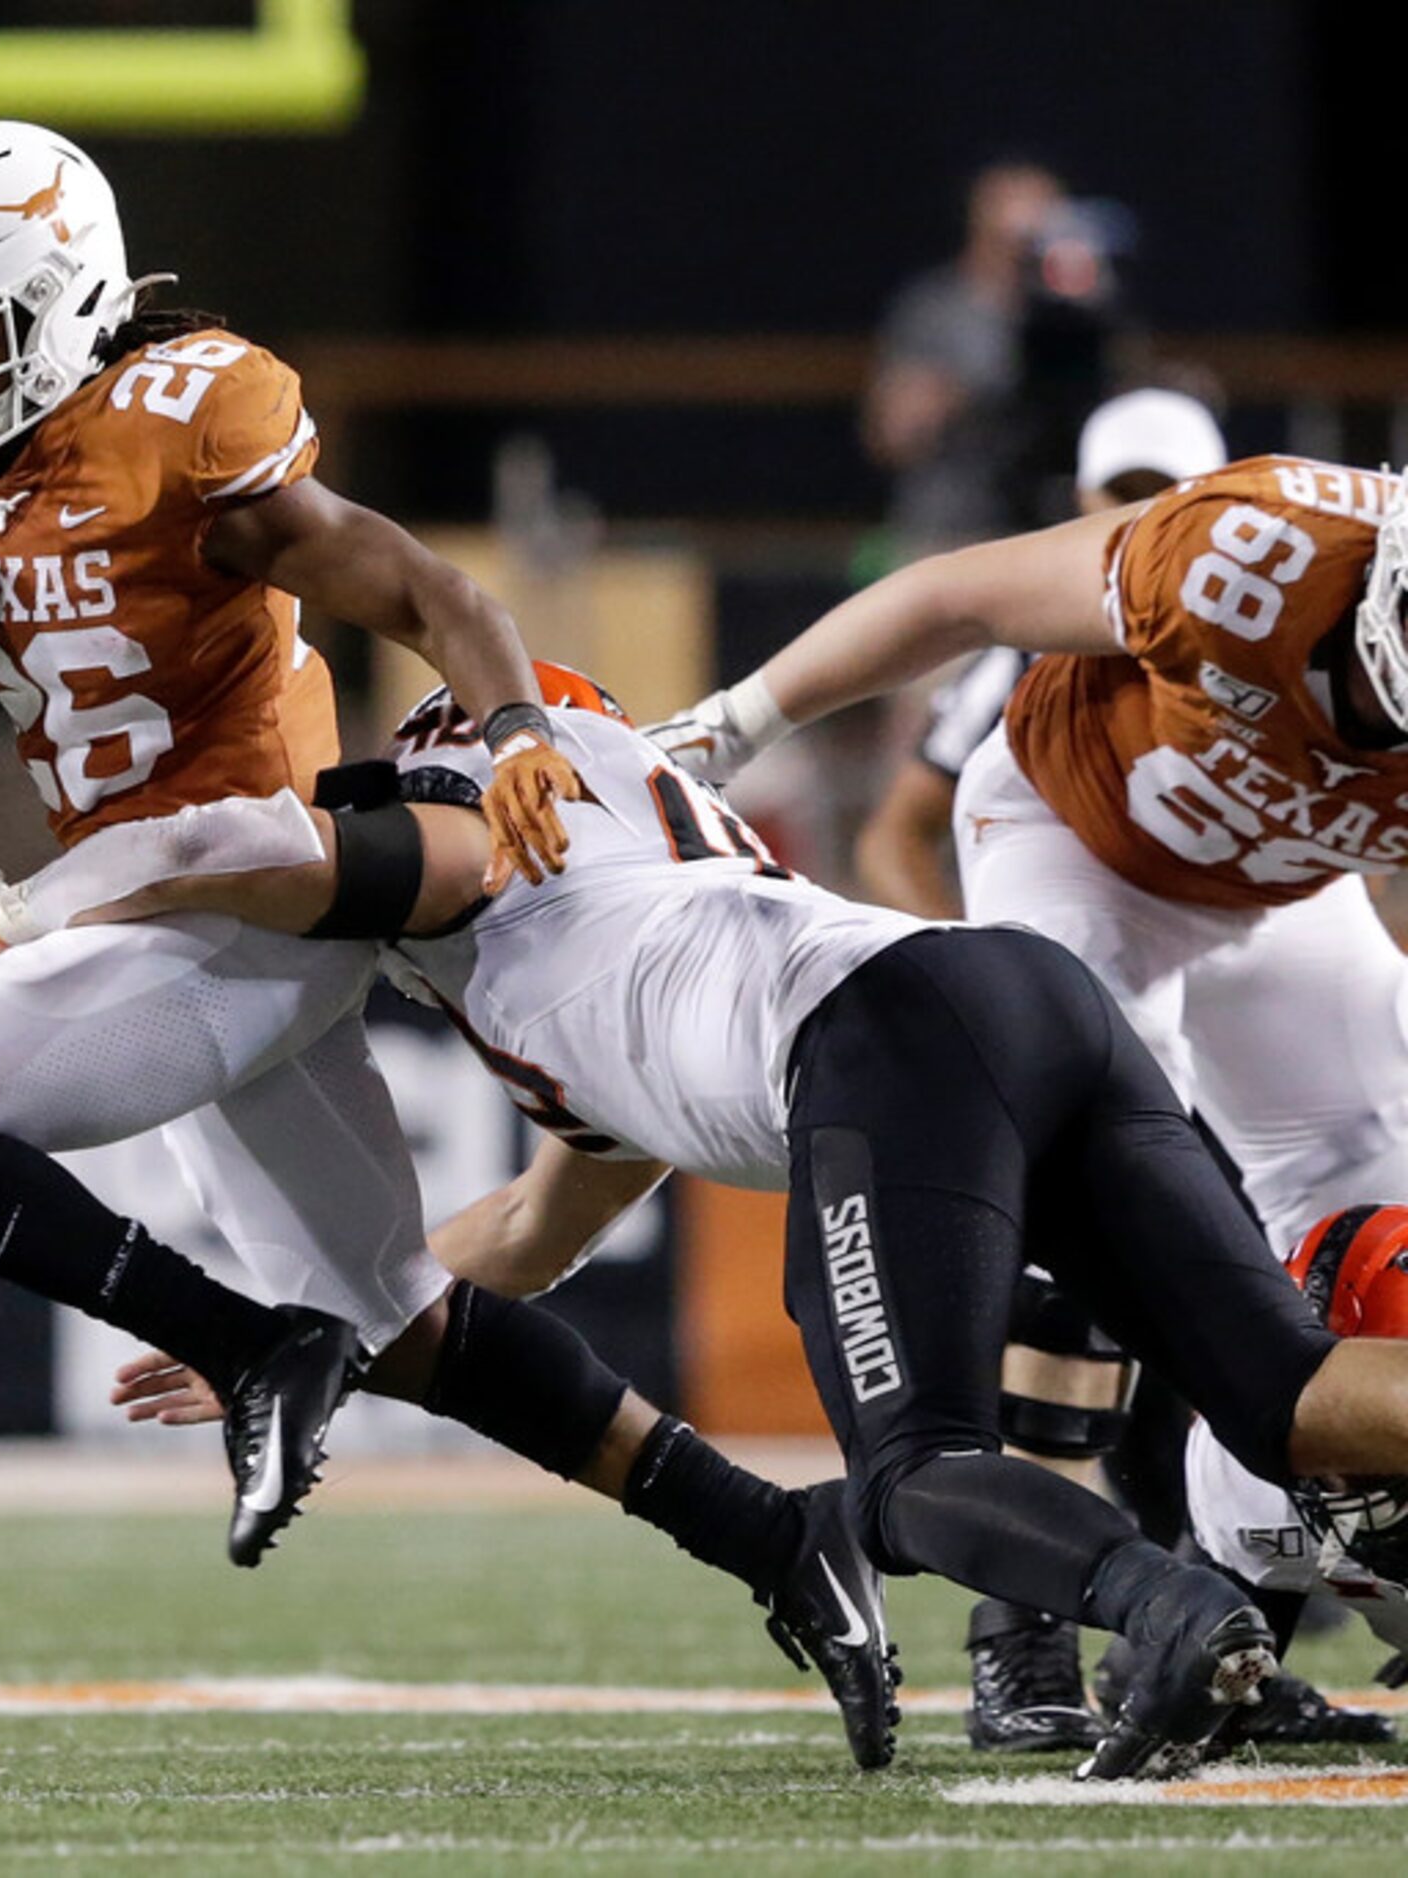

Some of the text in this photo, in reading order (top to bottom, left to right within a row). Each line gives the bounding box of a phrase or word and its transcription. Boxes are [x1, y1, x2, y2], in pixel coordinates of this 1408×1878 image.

[110, 329, 249, 424] 26
[1179, 504, 1317, 642] 68
[1194, 738, 1408, 862] TEXAS
[822, 1193, 904, 1403] COWBOYS
